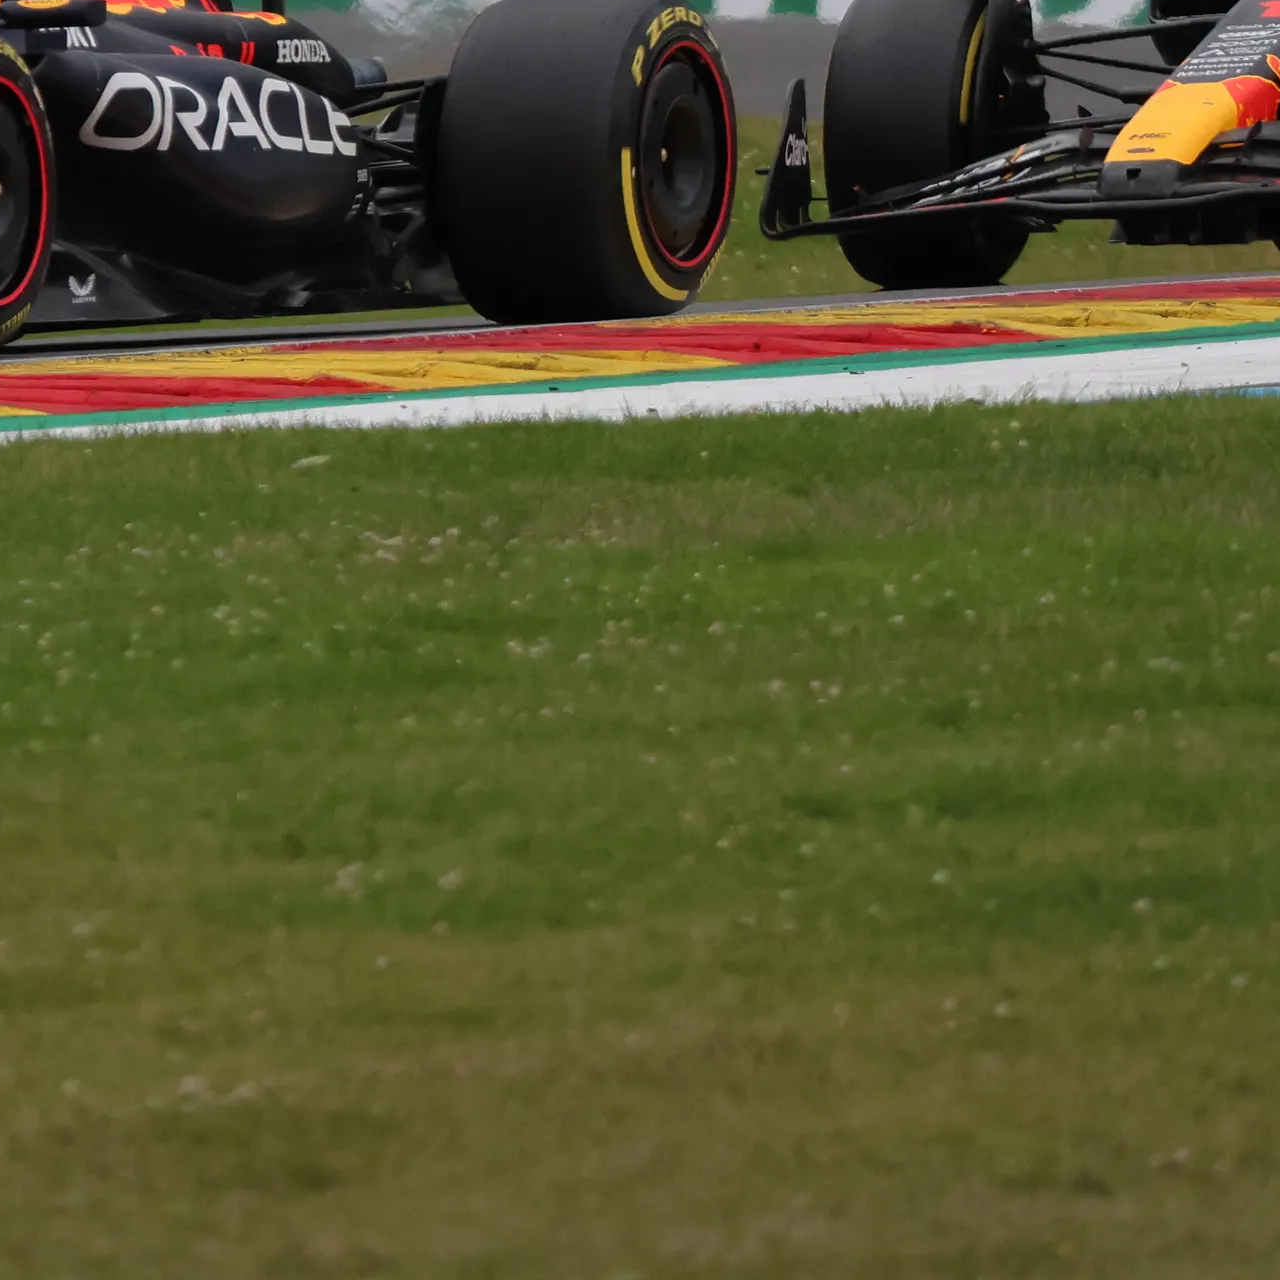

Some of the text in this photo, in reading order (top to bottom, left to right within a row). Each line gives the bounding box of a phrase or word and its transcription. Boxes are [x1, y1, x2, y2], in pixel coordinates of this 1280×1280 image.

[645, 5, 703, 50] ZERO
[276, 38, 332, 64] HONDA
[78, 71, 358, 157] ORACLE
